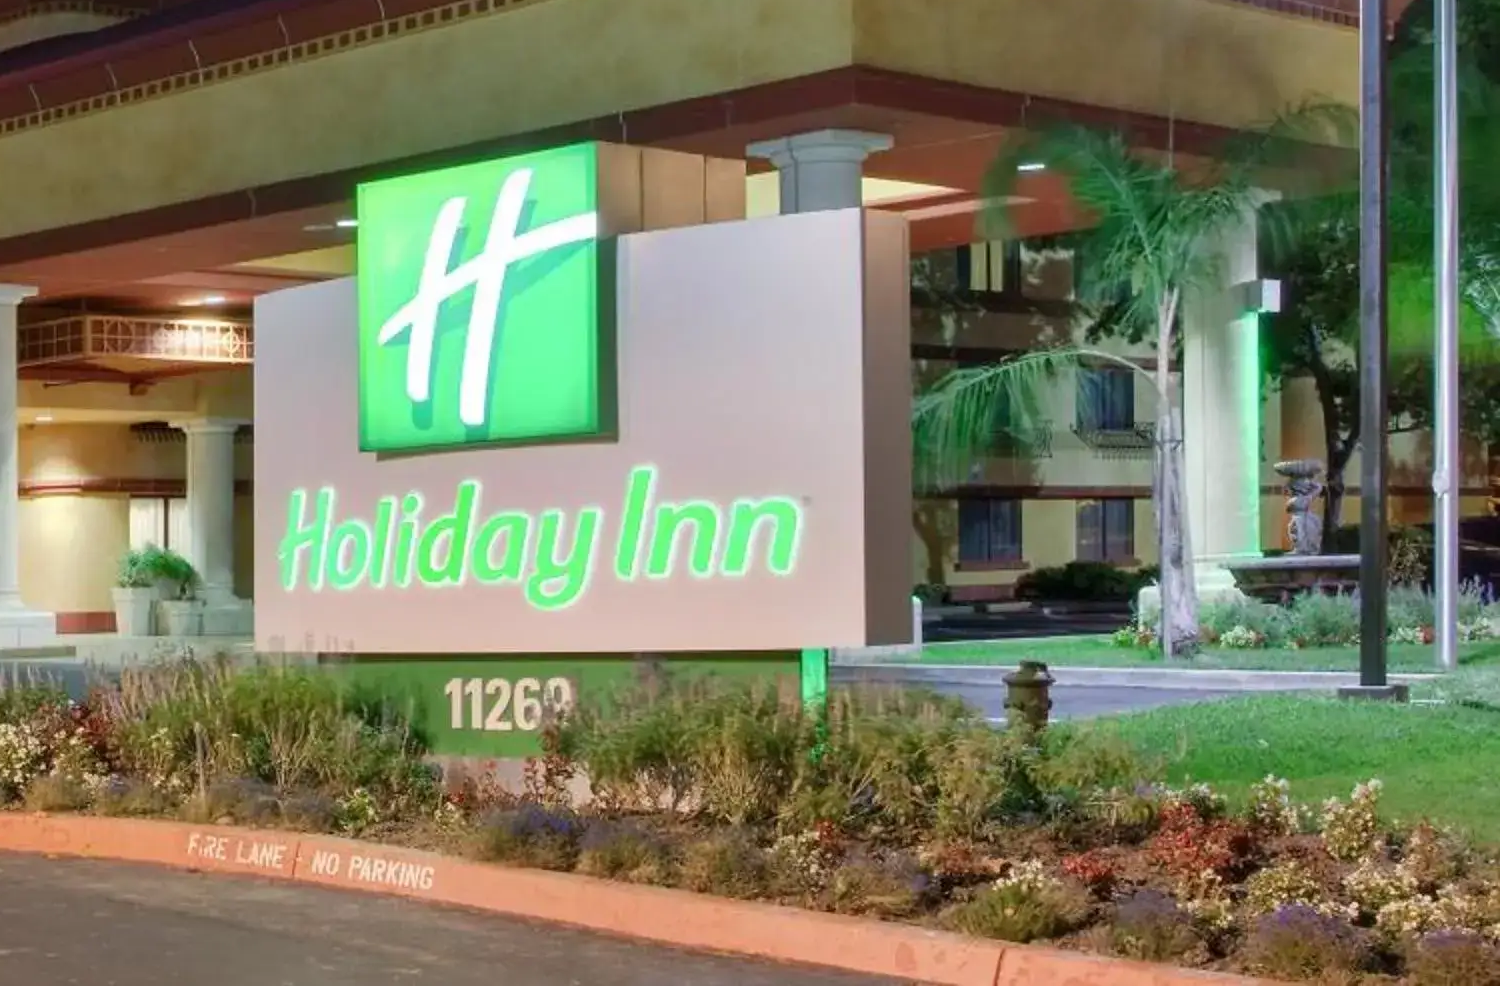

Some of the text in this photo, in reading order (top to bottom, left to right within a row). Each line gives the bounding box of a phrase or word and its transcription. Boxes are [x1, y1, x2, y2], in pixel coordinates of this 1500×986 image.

[277, 465, 802, 610] Holiday Inn
[187, 833, 229, 860] FIRE
[236, 840, 288, 869] LANE
[311, 850, 340, 875] NO
[348, 856, 435, 890] PARKING
